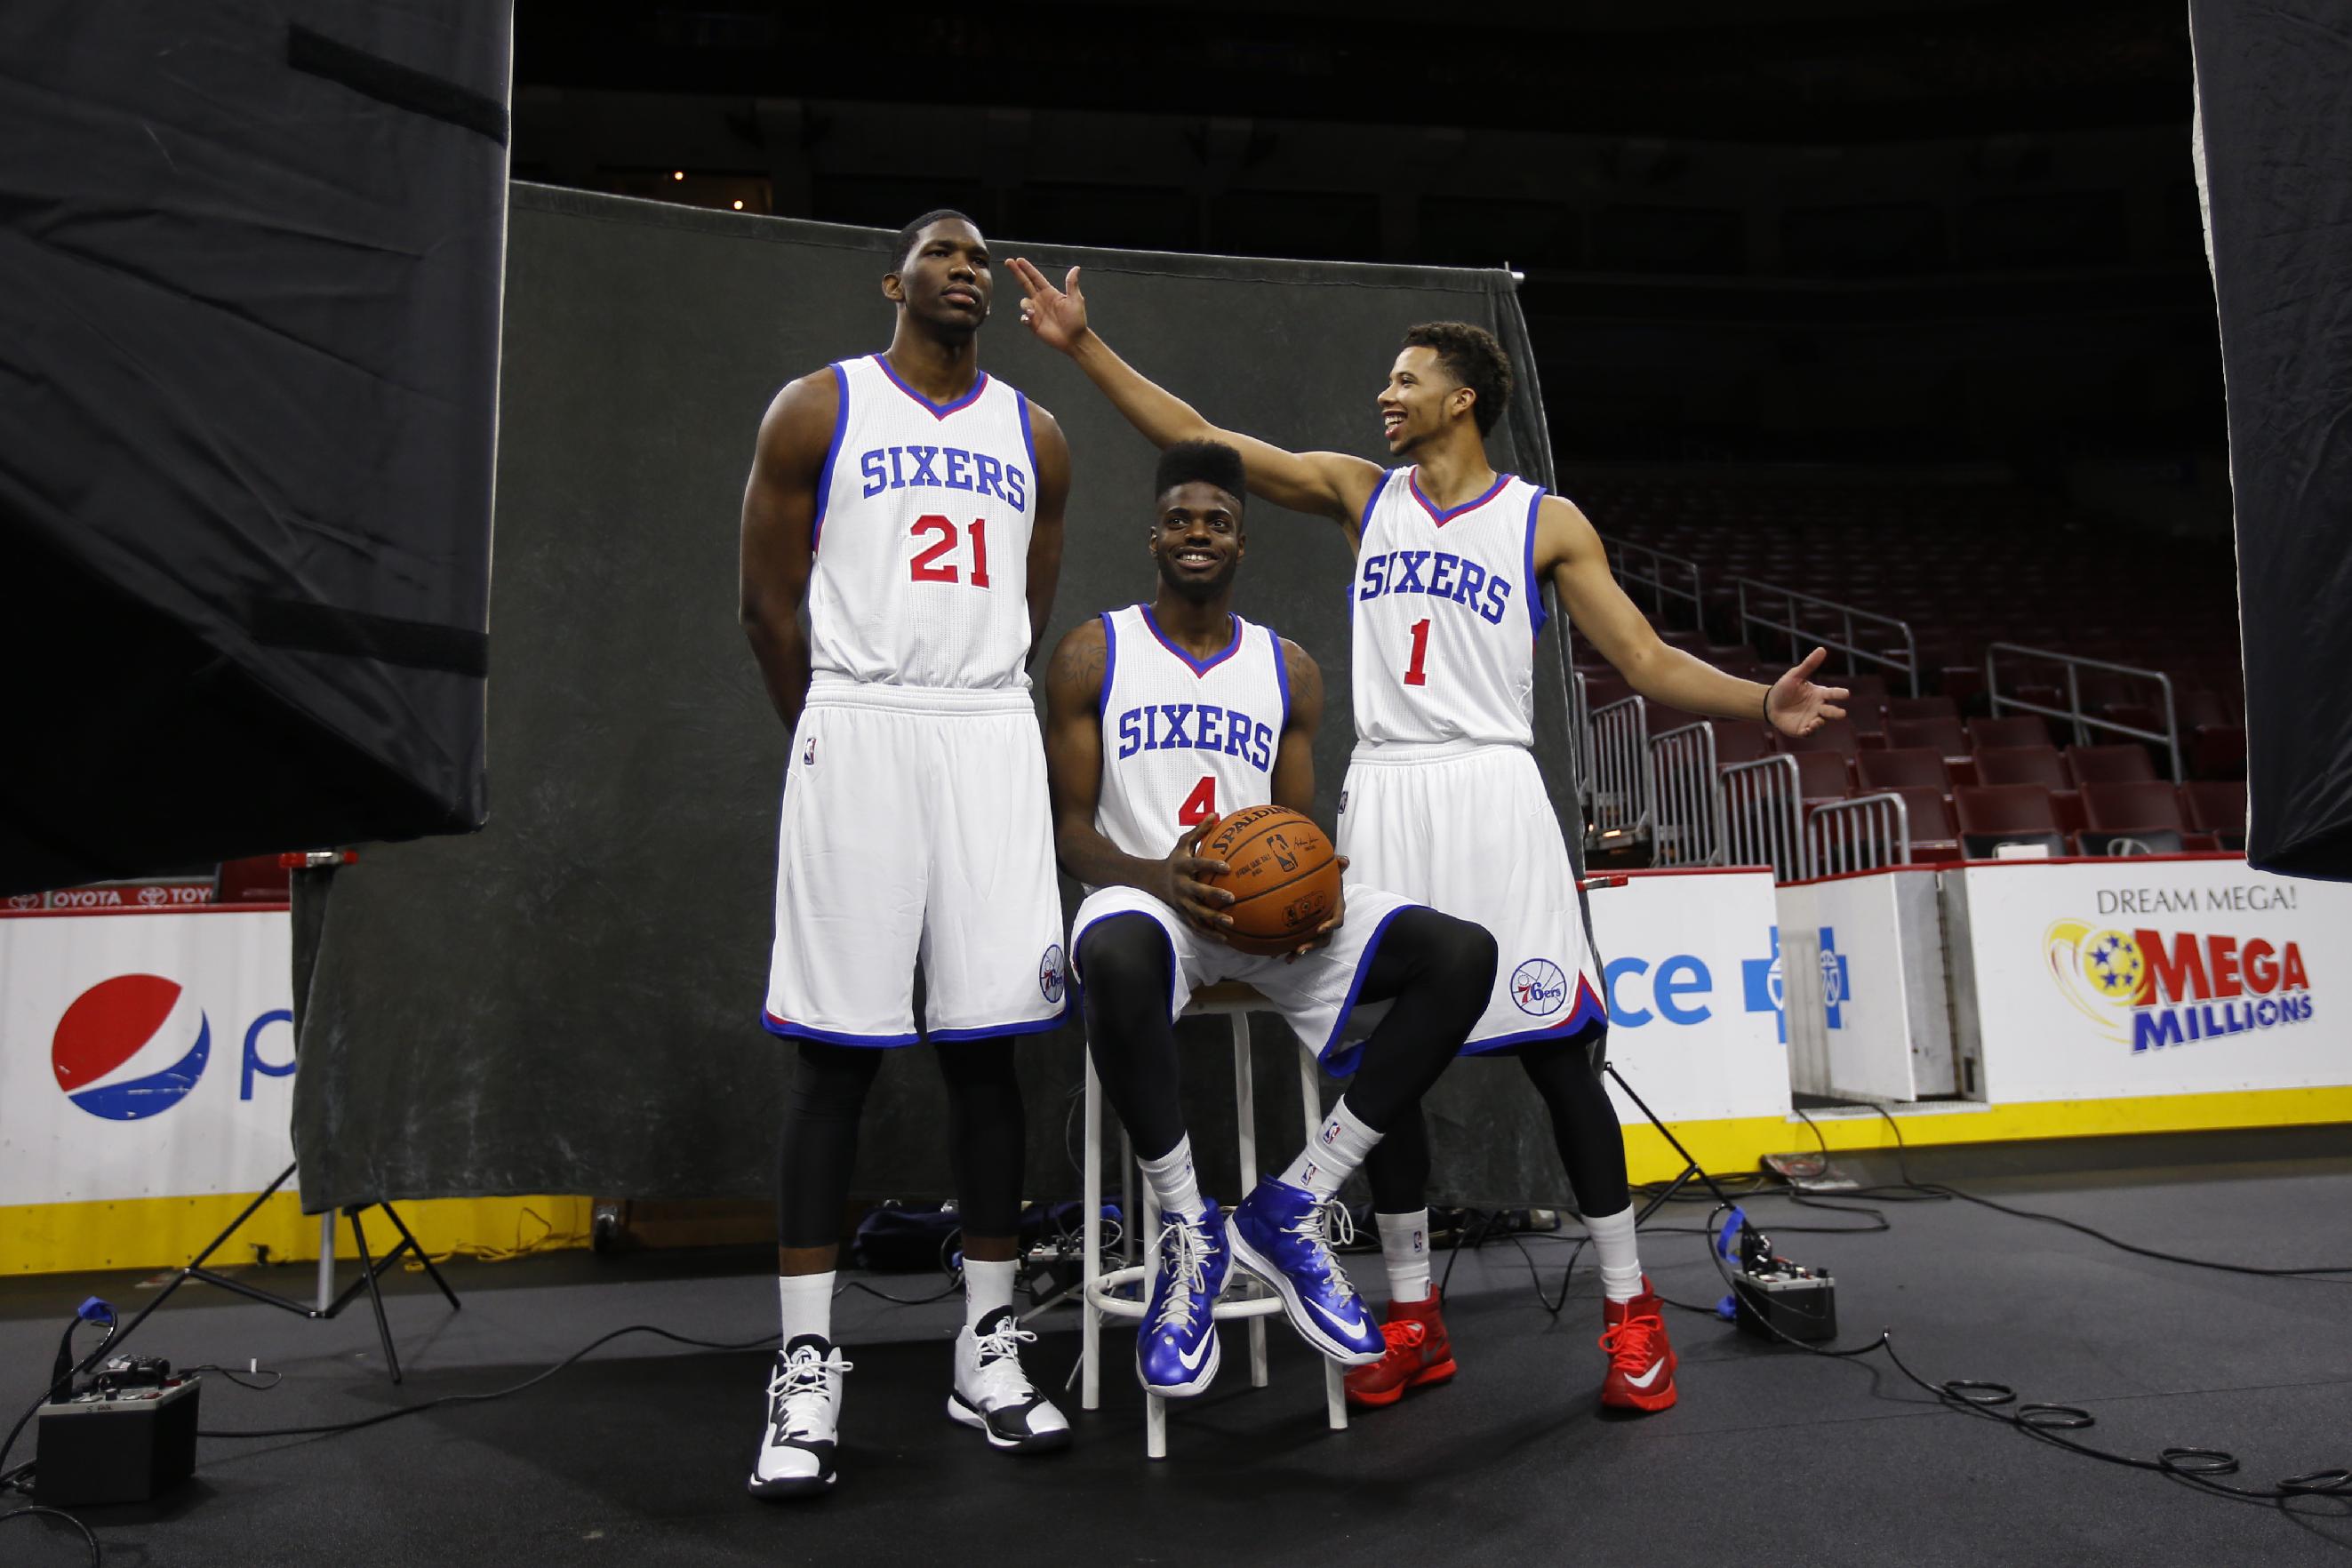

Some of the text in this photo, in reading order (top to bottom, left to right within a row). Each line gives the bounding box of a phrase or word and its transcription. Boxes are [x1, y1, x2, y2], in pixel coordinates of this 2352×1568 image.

[860, 445, 1026, 514] SIXERS
[909, 514, 990, 589] 21
[1359, 550, 1512, 626] SIXERS
[1403, 618, 1431, 686] 1
[1118, 703, 1274, 773] SIXERS
[1178, 776, 1221, 827] 4
[44, 887, 213, 908] OYOTA TOY
[2097, 884, 2298, 915] DREAM MEGA!
[1517, 981, 1562, 1004] 76ers
[1603, 954, 1714, 1029] ce
[2133, 928, 2311, 1007] MEGA
[2132, 994, 2314, 1053] MILLIONS
